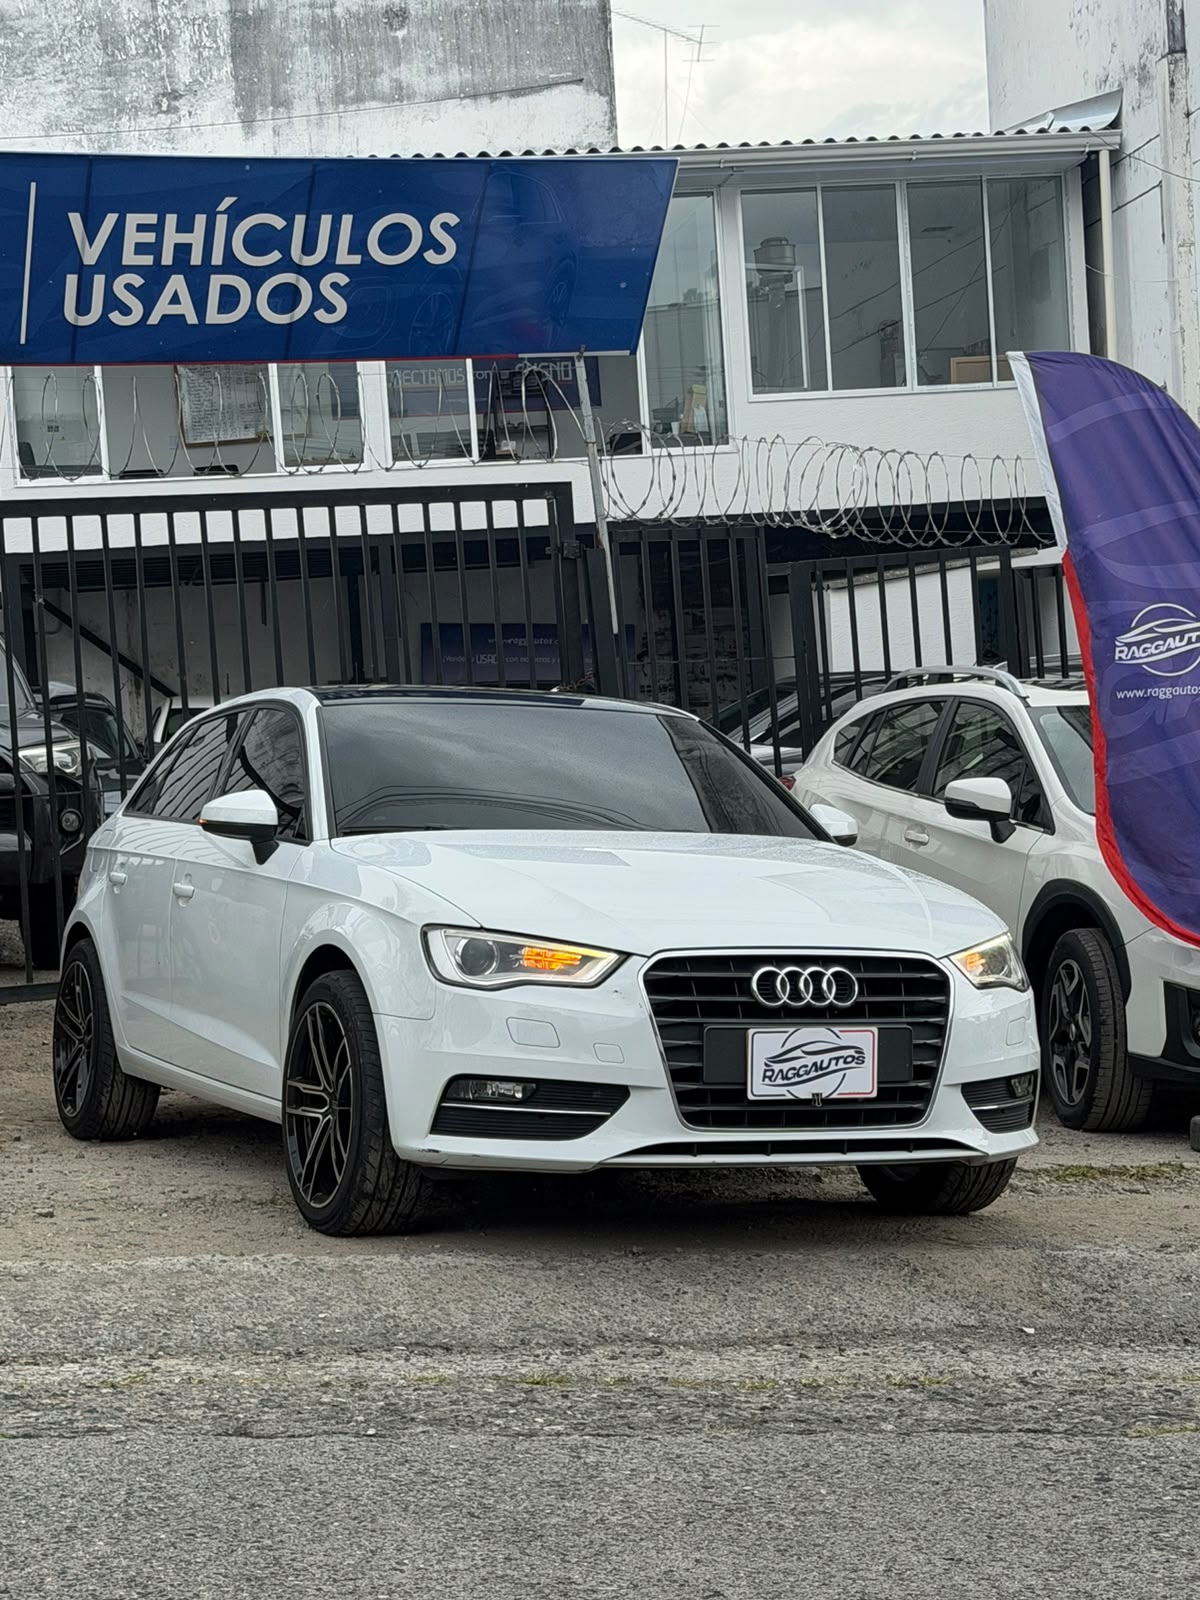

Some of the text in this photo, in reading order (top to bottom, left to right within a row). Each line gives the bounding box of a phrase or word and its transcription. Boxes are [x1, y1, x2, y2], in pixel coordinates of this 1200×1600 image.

[67, 197, 461, 267] VEHÍCULOS
[63, 272, 351, 326] USADOS
[1115, 631, 1200, 661] RAGGAUT
[761, 1054, 866, 1083] RAGGAUTOS
